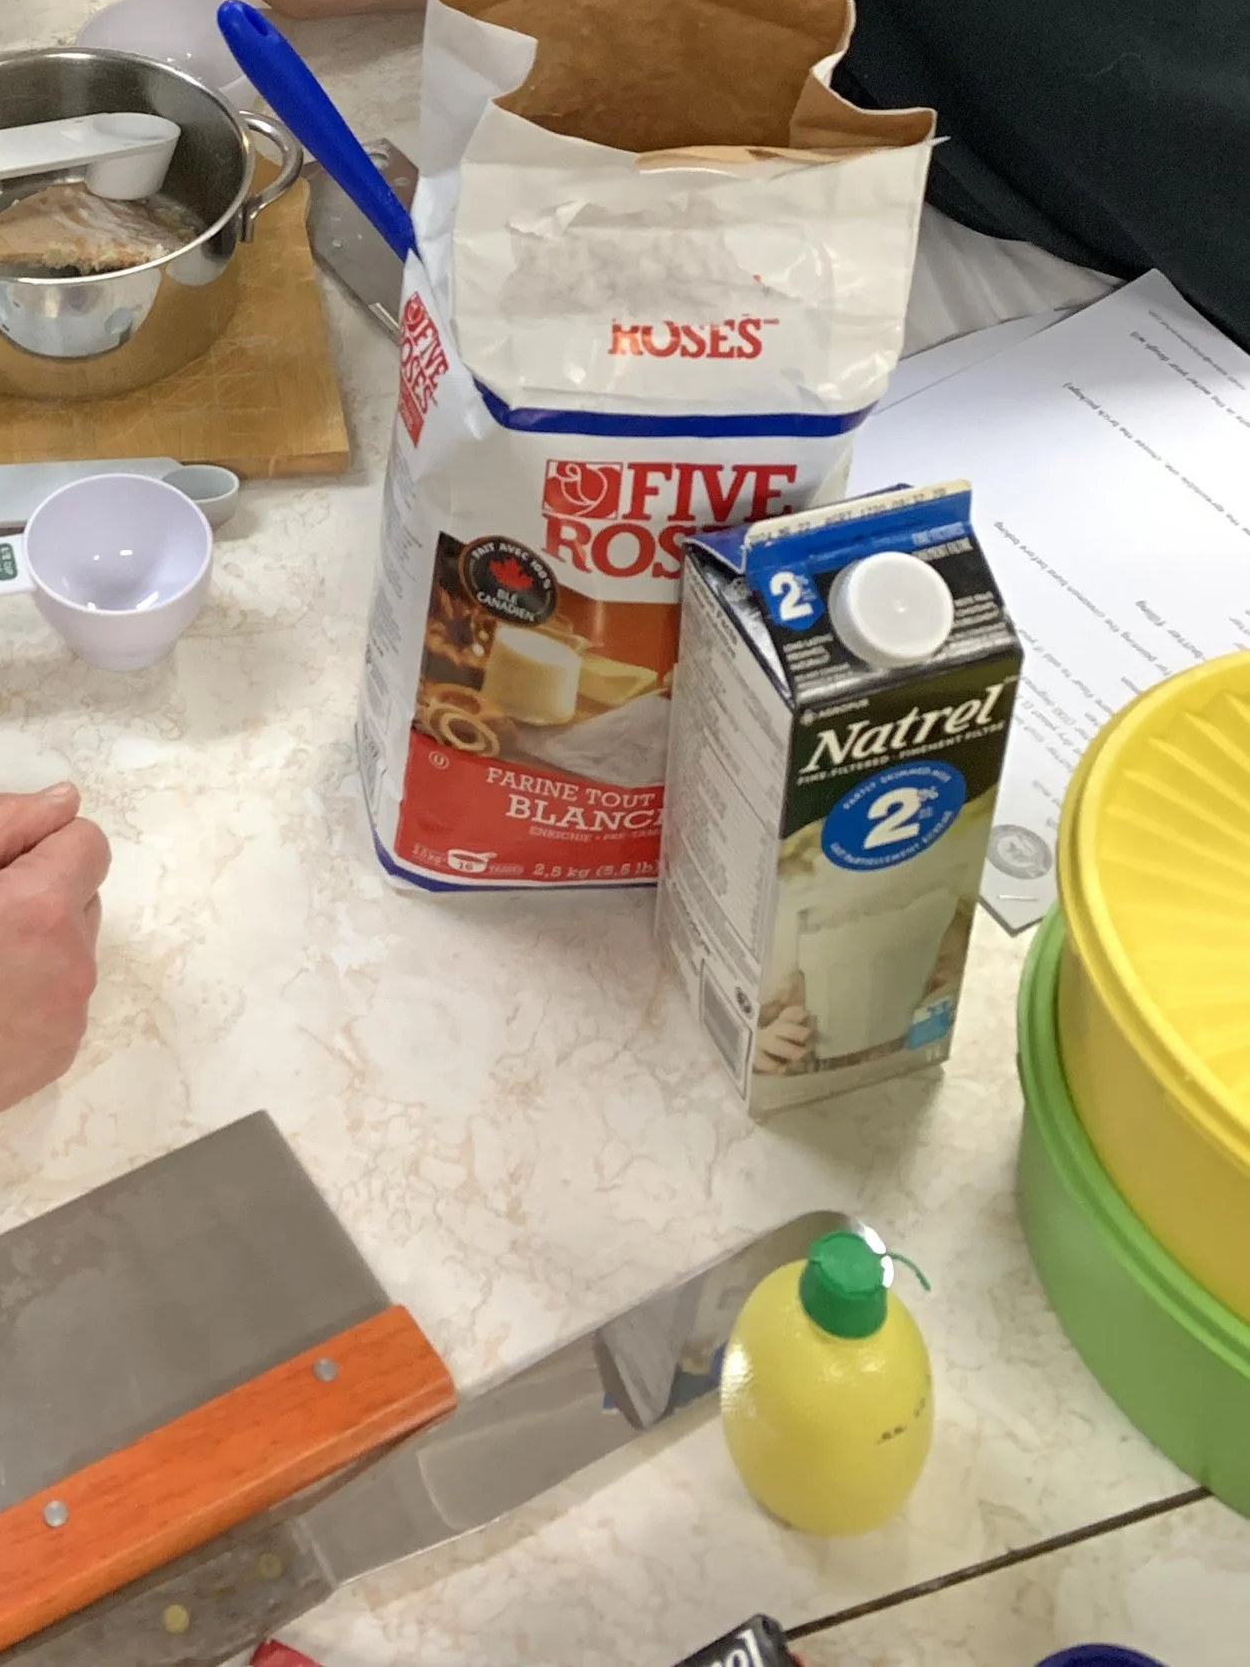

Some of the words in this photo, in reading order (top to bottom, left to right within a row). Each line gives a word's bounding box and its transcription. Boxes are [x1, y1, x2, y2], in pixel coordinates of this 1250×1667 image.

[621, 461, 798, 523] FIVE
[541, 517, 738, 580] ROS
[476, 590, 535, 622] CANADIEN
[1136, 601, 1165, 626] filling
[798, 682, 1004, 775] Natrel
[485, 766, 580, 804] FARINE
[585, 787, 656, 809] TOUT
[505, 792, 664, 832] BLANC
[565, 864, 590, 880] kg
